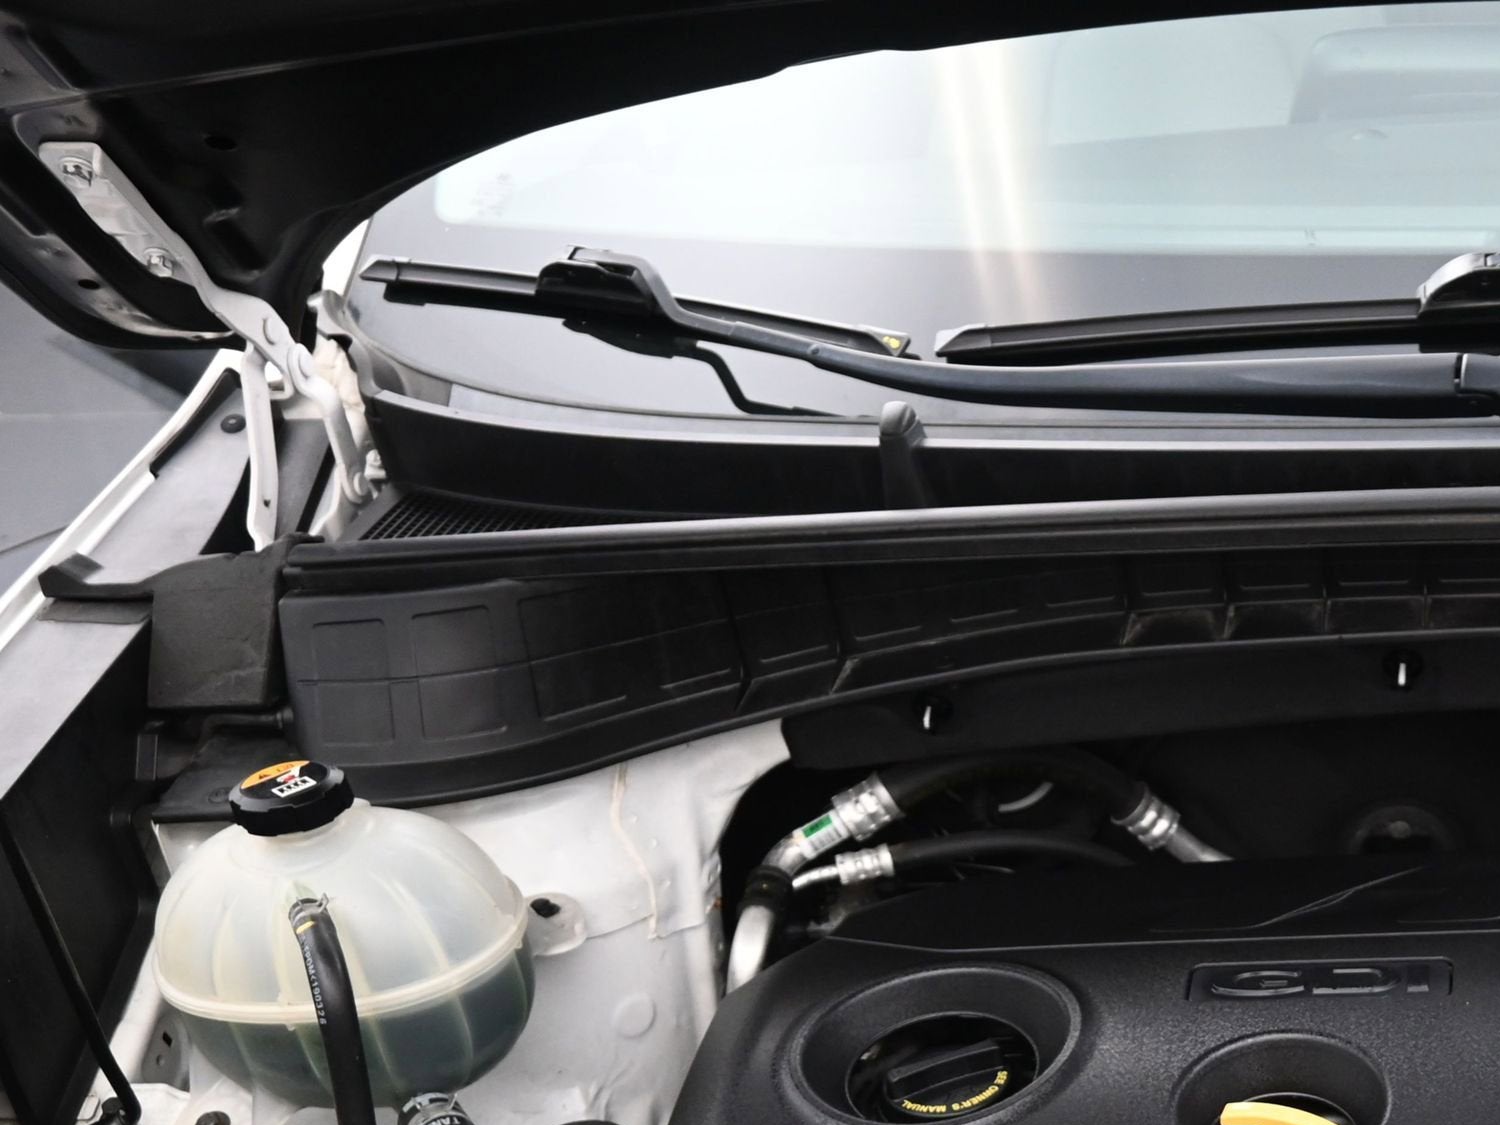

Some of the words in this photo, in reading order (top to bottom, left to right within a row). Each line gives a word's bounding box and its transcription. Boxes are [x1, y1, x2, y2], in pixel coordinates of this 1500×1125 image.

[1211, 966, 1429, 997] GDI
[994, 1071, 1008, 1084] SEE
[902, 1099, 947, 1113] MANUAL
[952, 1085, 999, 1111] OWNER'S
